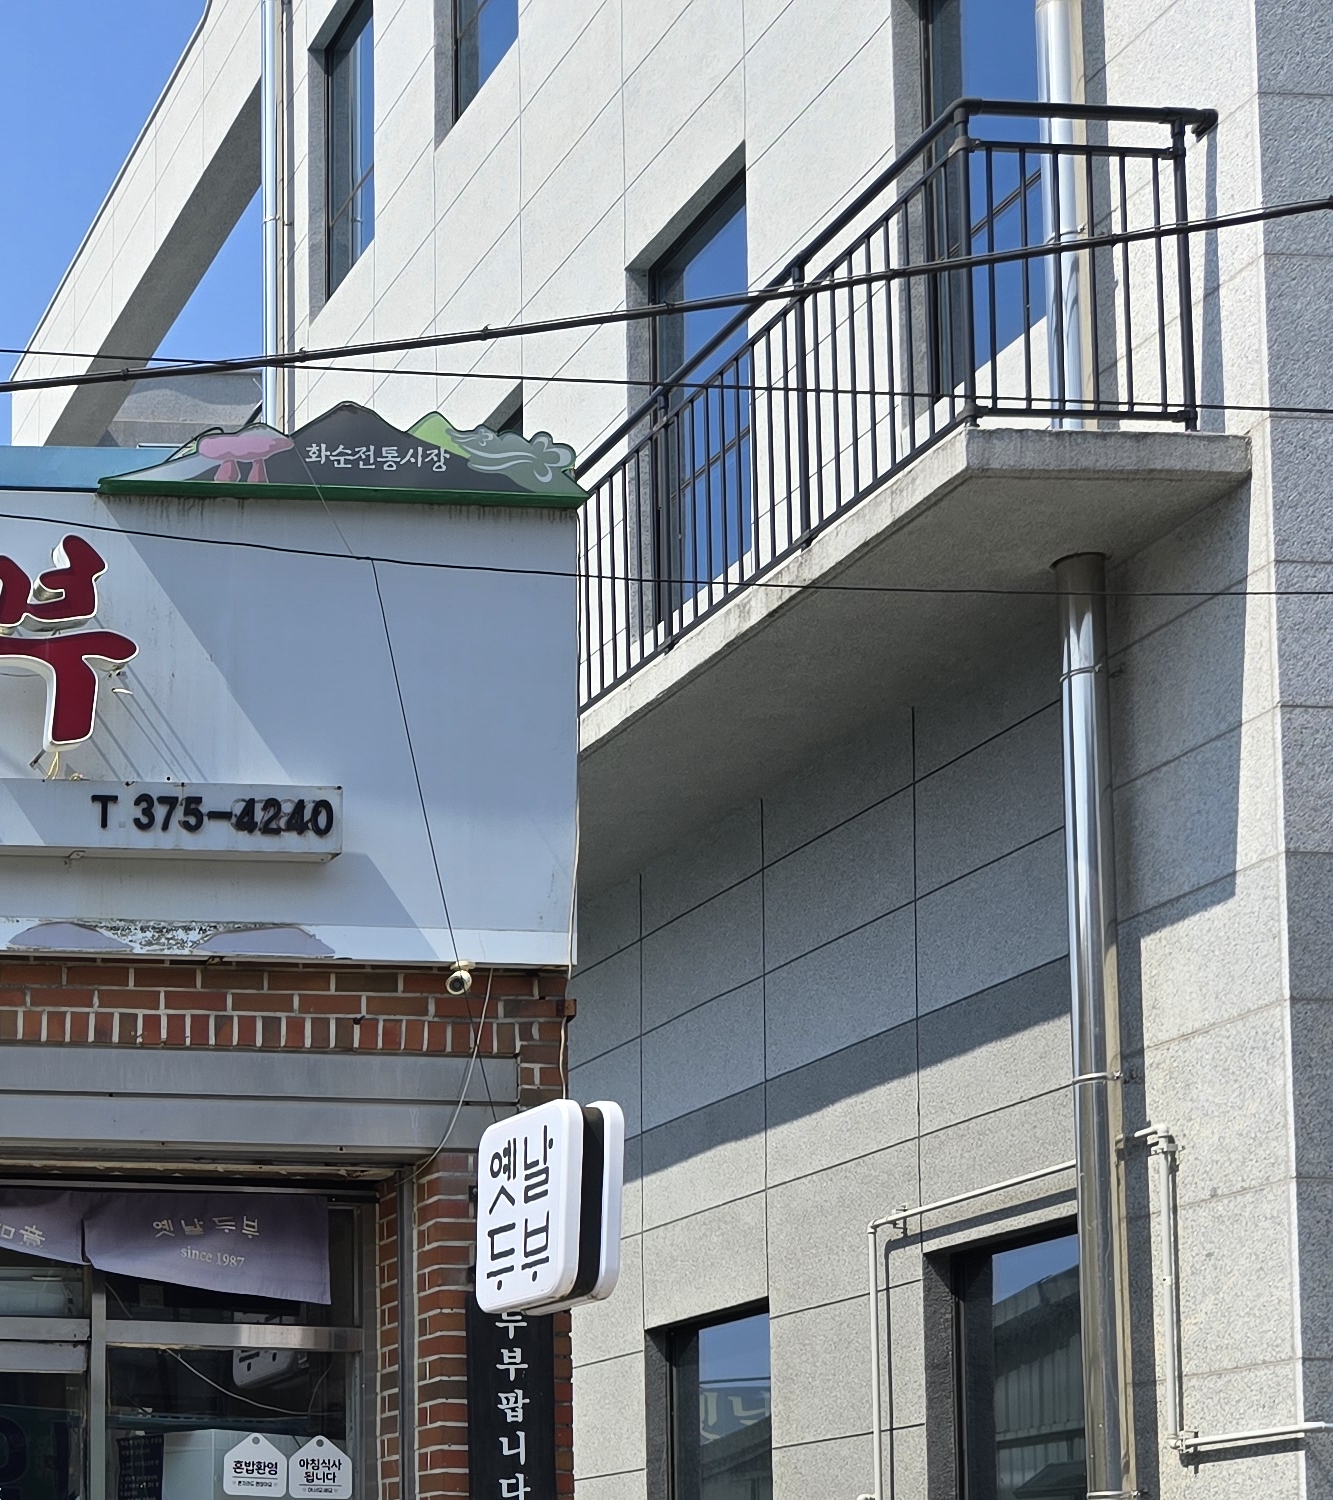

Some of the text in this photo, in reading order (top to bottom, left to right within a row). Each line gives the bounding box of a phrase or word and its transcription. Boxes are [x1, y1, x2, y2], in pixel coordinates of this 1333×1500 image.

[305, 443, 451, 472] 화순전통시장
[133, 793, 335, 836] 375-4240
[489, 1124, 553, 1215] 옛날
[180, 1245, 245, 1269] since 1987
[486, 1211, 550, 1291] 두부
[232, 1460, 278, 1475] 혼밥환영
[299, 1458, 342, 1471] 아침식사
[304, 1471, 336, 1483] 됩니다
